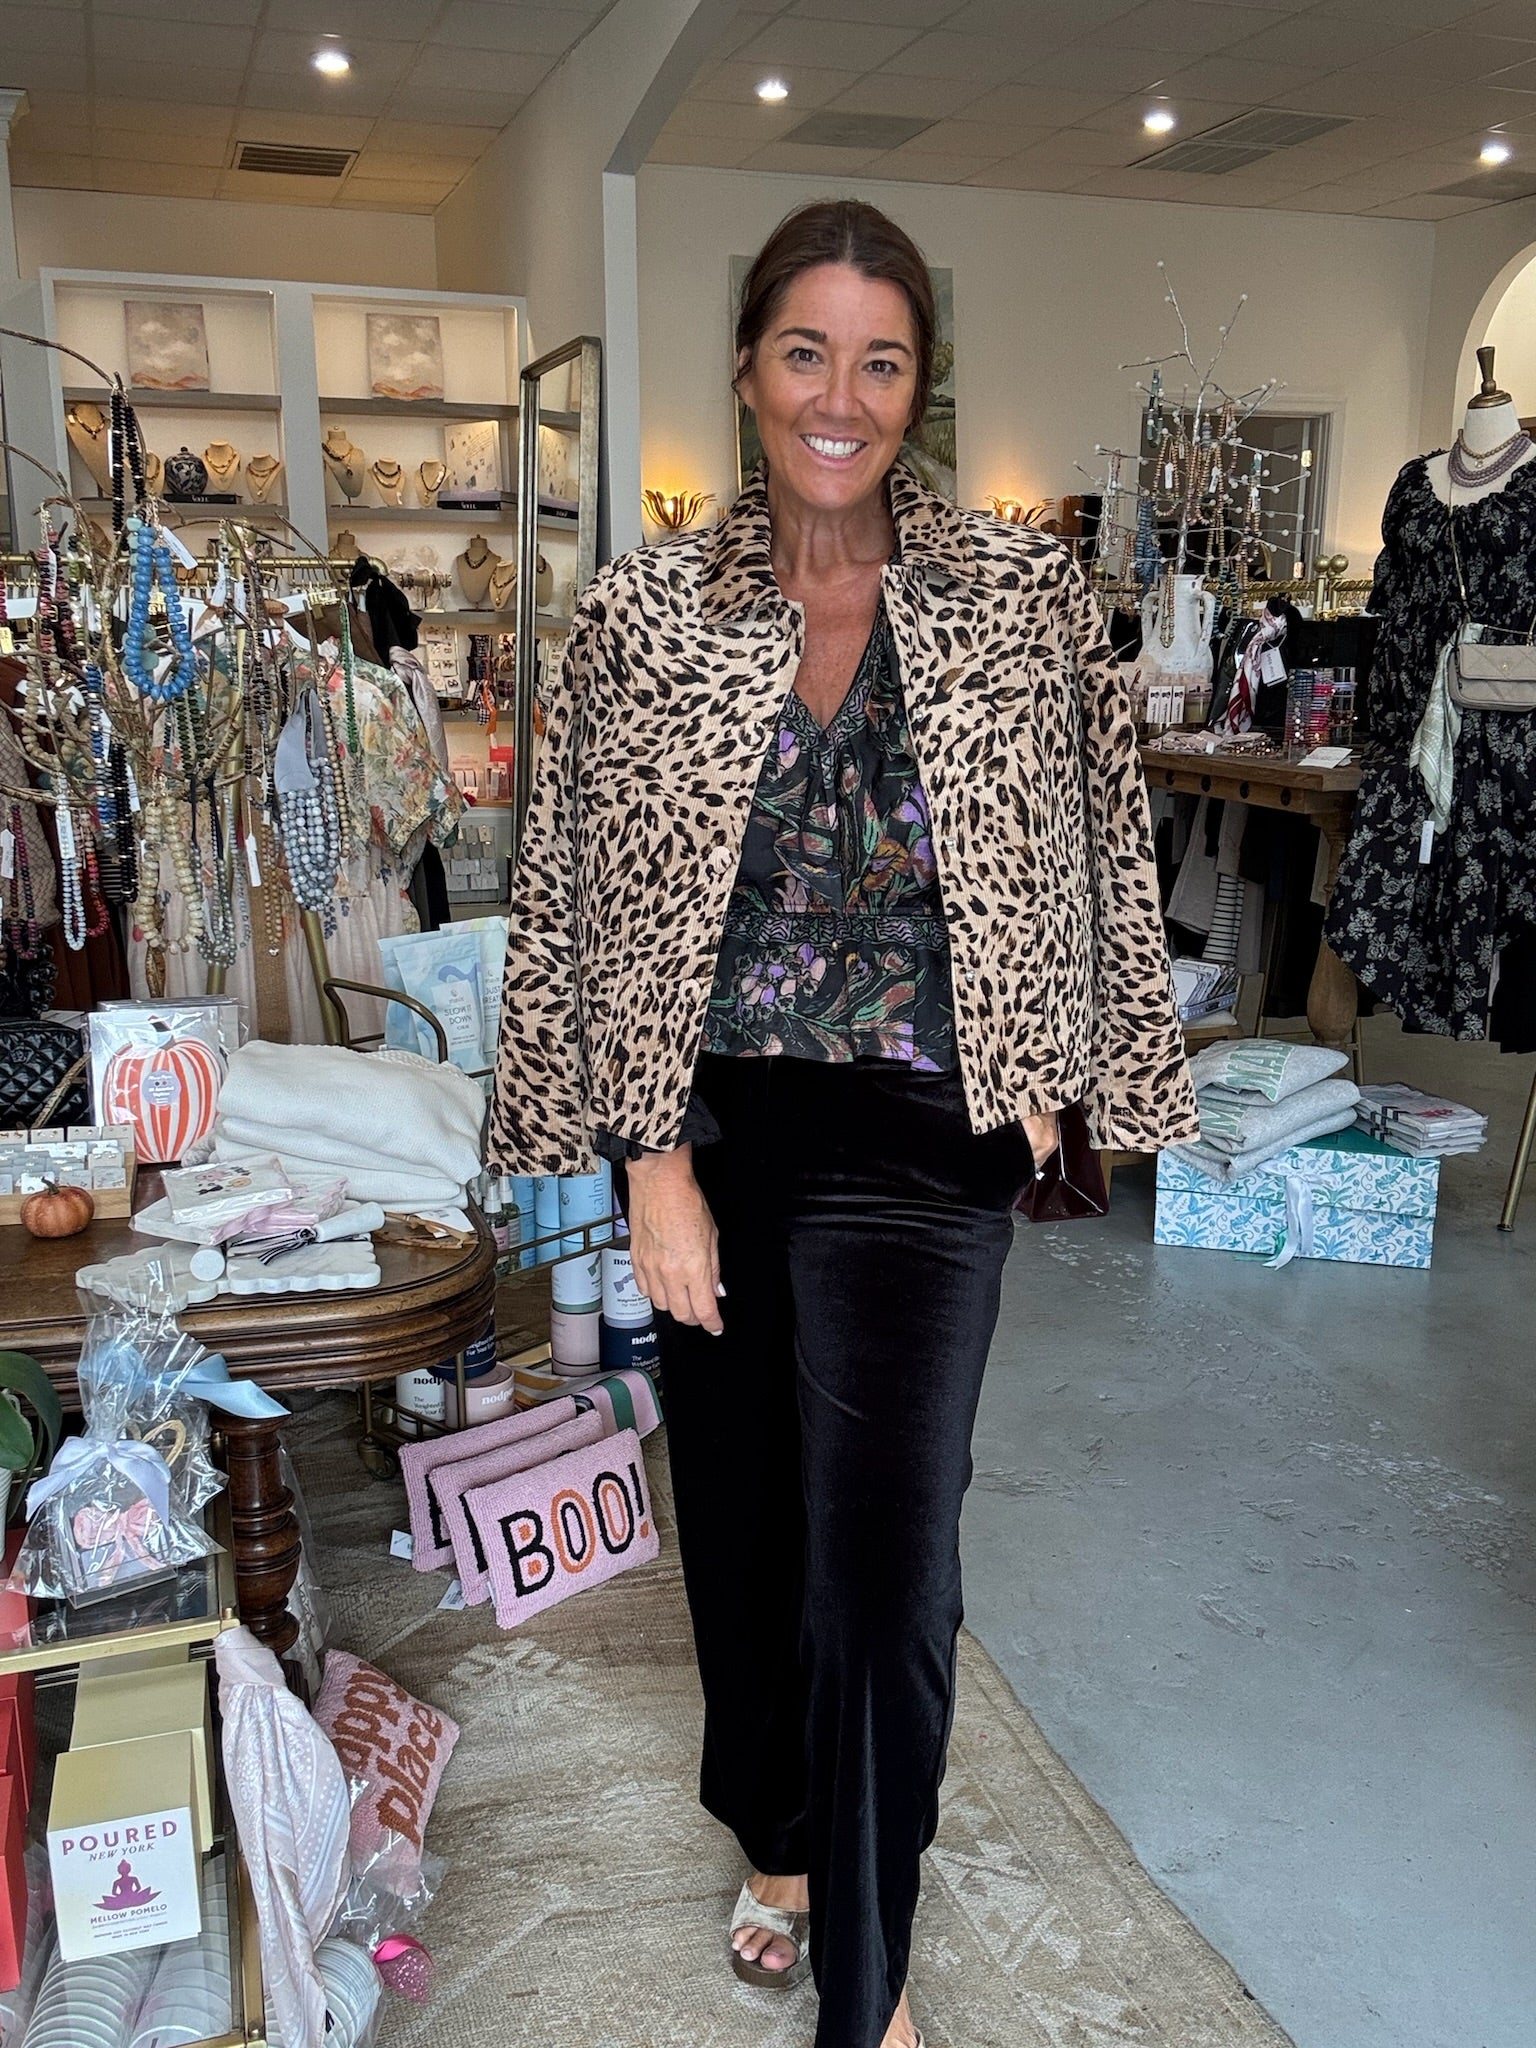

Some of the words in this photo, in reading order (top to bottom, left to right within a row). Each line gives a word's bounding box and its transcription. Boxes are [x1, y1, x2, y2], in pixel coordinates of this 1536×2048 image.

[449, 1015, 472, 1024] DOWN
[588, 1177, 604, 1216] calm
[631, 1332, 657, 1345] nodp
[413, 1376, 444, 1386] nodp
[498, 1462, 649, 1597] BOO!
[376, 1702, 443, 1854] place
[62, 1820, 177, 1855] POURED
[89, 1849, 118, 1862] NEW
[121, 1842, 155, 1856] YORK
[90, 1912, 127, 1924] MELLOW
[130, 1904, 168, 1916] POMELO
